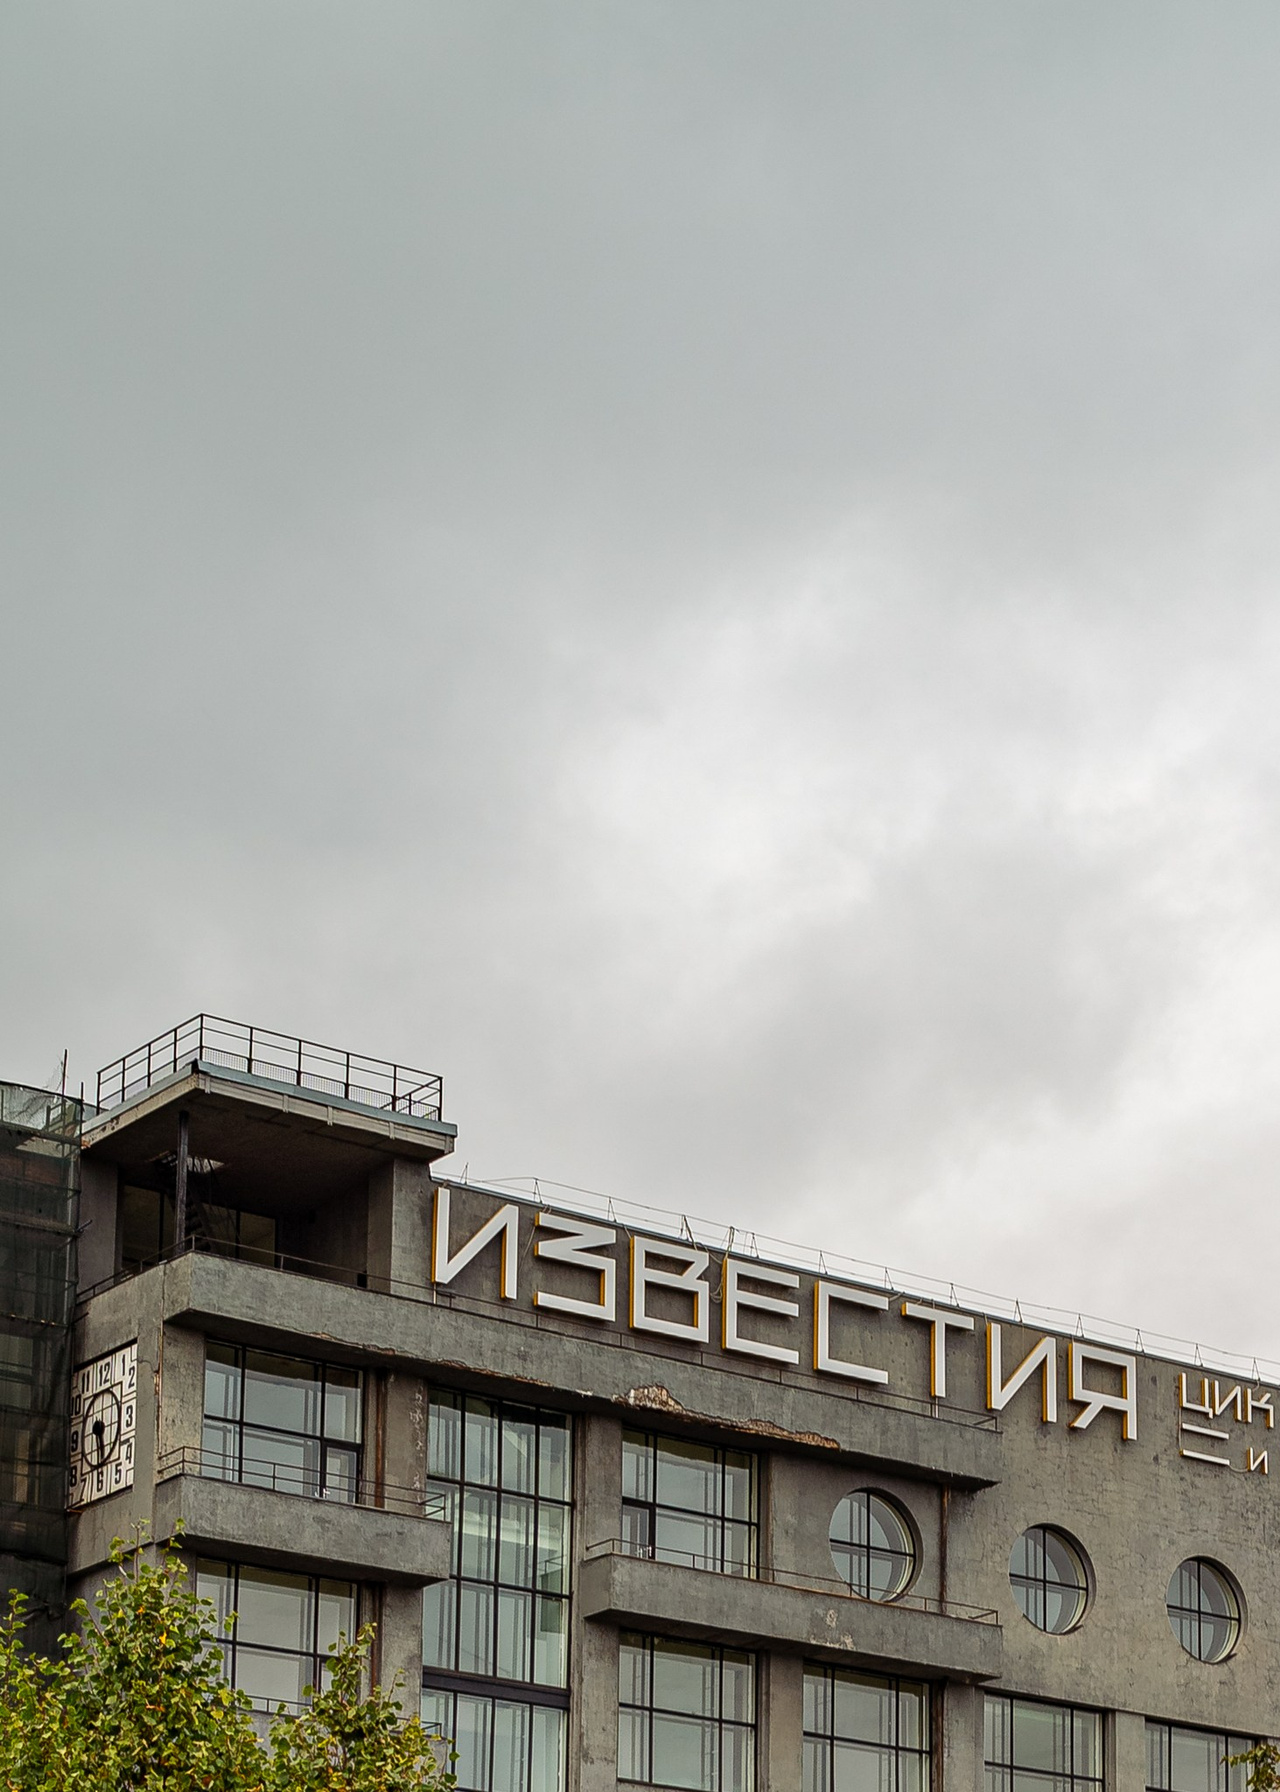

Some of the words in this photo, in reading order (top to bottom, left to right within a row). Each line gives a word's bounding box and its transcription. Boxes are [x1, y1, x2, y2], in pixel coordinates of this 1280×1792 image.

[431, 1185, 1139, 1441] ИЗВЕСТИЯ
[99, 1361, 111, 1387] 12
[128, 1365, 135, 1389] 2
[1179, 1372, 1274, 1429] ЦИК
[125, 1404, 133, 1428] 3
[71, 1430, 79, 1453] 9
[125, 1441, 132, 1465] 4
[70, 1465, 77, 1487] 8
[96, 1469, 103, 1492] 6
[114, 1461, 122, 1485] 5
